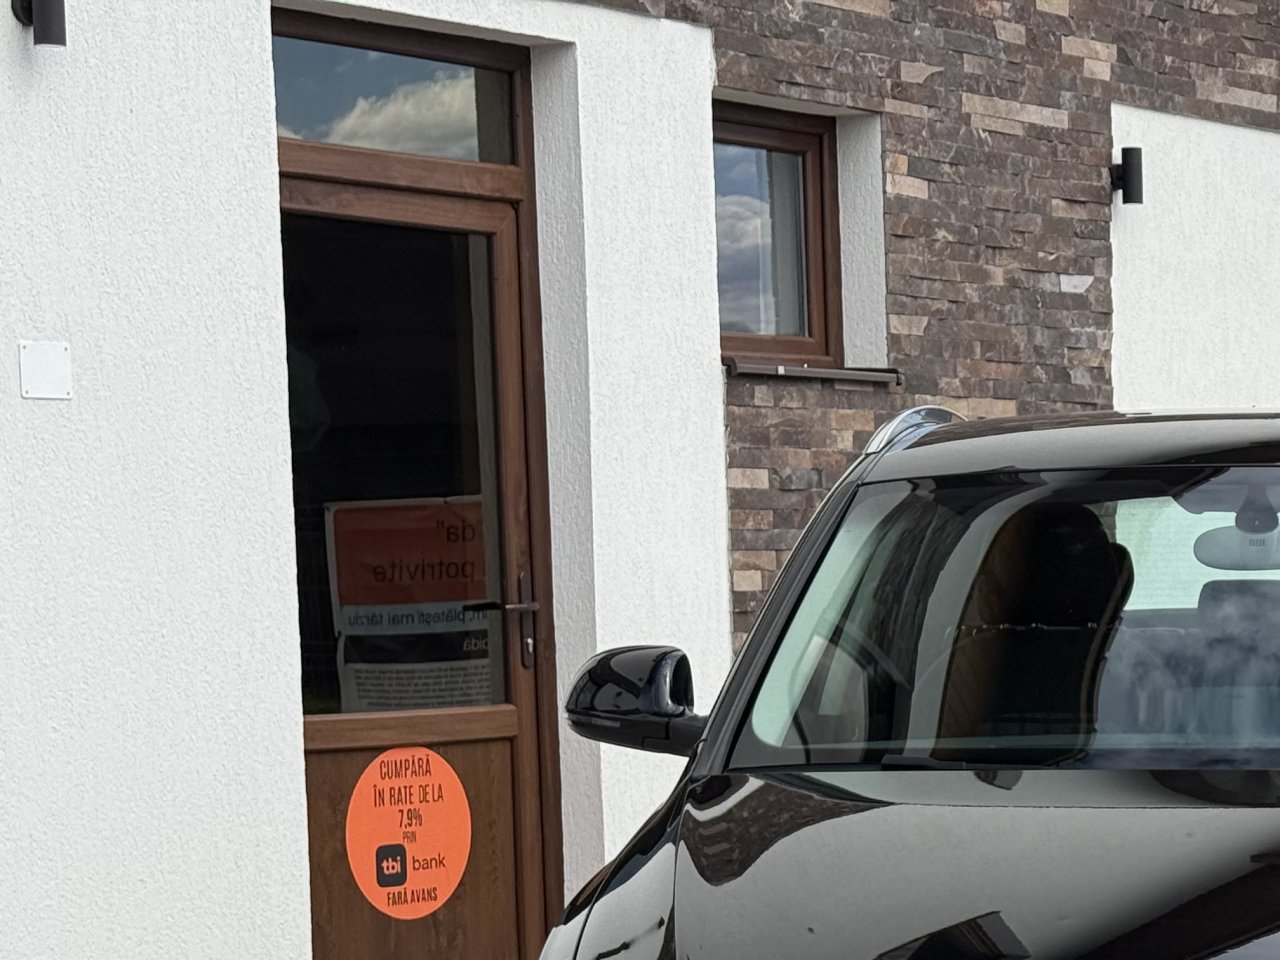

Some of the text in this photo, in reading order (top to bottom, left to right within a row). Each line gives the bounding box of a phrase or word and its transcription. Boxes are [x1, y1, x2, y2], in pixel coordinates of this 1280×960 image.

[380, 754, 432, 780] CUMPĂRĂ
[373, 783, 444, 808] ÎN RATE DE LA
[398, 808, 423, 830] 7,9%
[381, 853, 446, 875] tbi bank
[410, 887, 438, 904] AVANS
